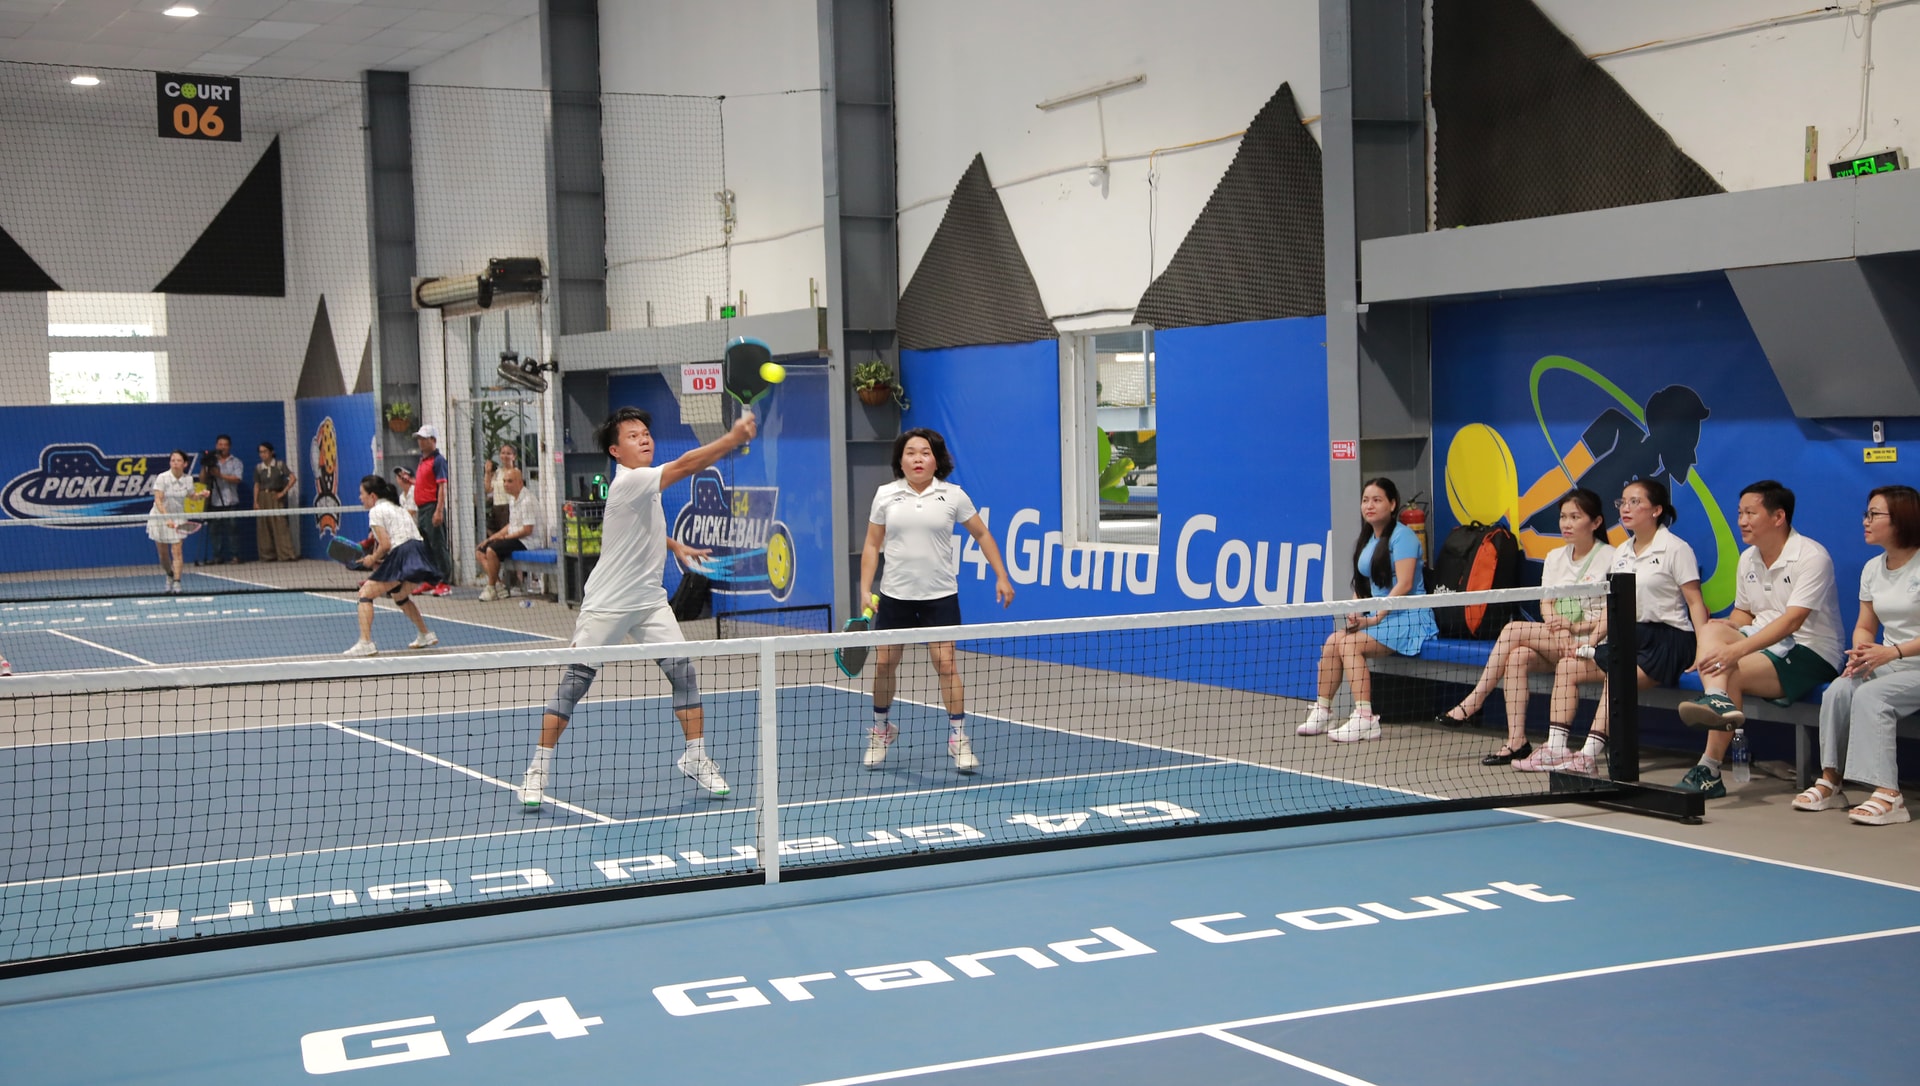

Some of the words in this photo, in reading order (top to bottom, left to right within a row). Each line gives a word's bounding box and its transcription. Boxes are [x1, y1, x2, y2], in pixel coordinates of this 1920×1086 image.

[164, 81, 232, 101] COURT
[173, 103, 225, 137] 06
[693, 377, 716, 390] 09
[115, 457, 148, 476] G4
[39, 474, 158, 499] PICKLEBA
[731, 490, 750, 517] G4
[691, 514, 768, 549] PICKLEBALL
[300, 994, 605, 1076] G4
[650, 925, 1159, 1018] Grand
[1169, 880, 1576, 944] Court
